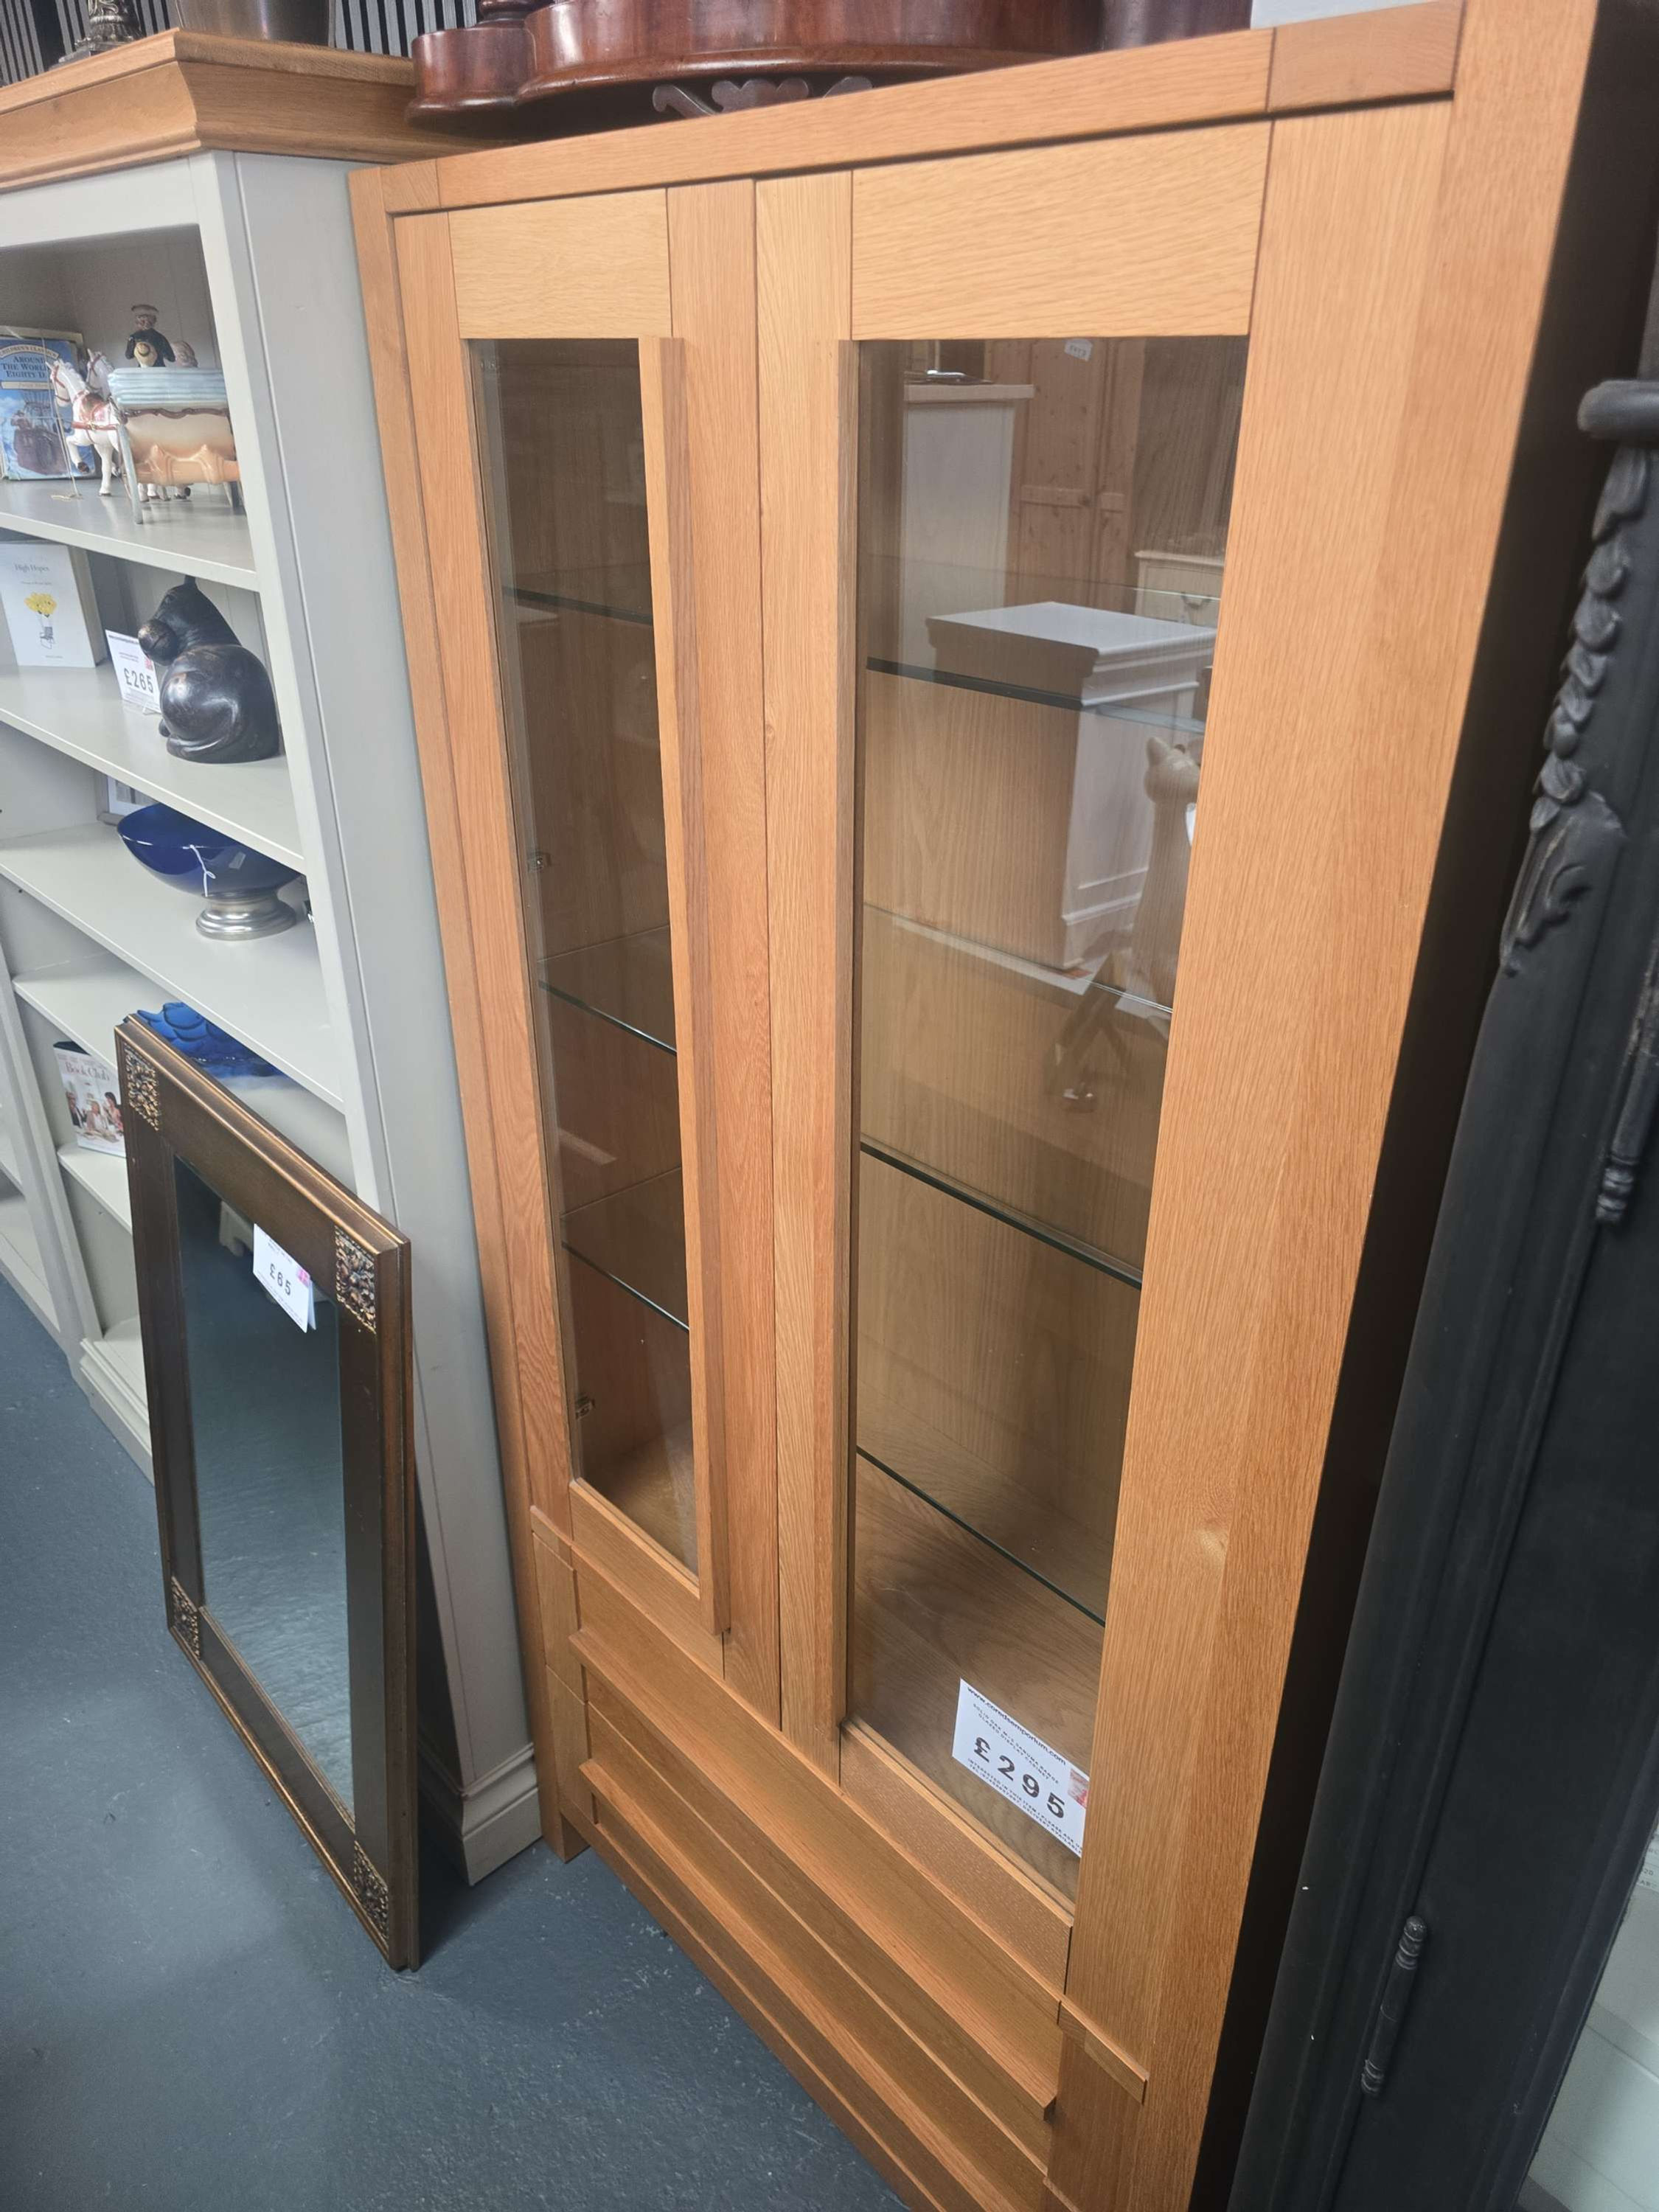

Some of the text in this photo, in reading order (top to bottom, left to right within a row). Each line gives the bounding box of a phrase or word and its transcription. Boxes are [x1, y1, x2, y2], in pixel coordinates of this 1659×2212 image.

[1, 363, 18, 371] THE
[6, 370, 35, 378] EIGHTY
[14, 563, 50, 574] High Hopes
[124, 668, 153, 693] £265
[65, 1061, 87, 1076] Book
[88, 1066, 110, 1080] Club
[270, 1263, 291, 1295] £65
[1000, 1733, 1023, 1756] DISPLAY
[1024, 1756, 1048, 1779] CABINET
[973, 1736, 1065, 1819] £295
